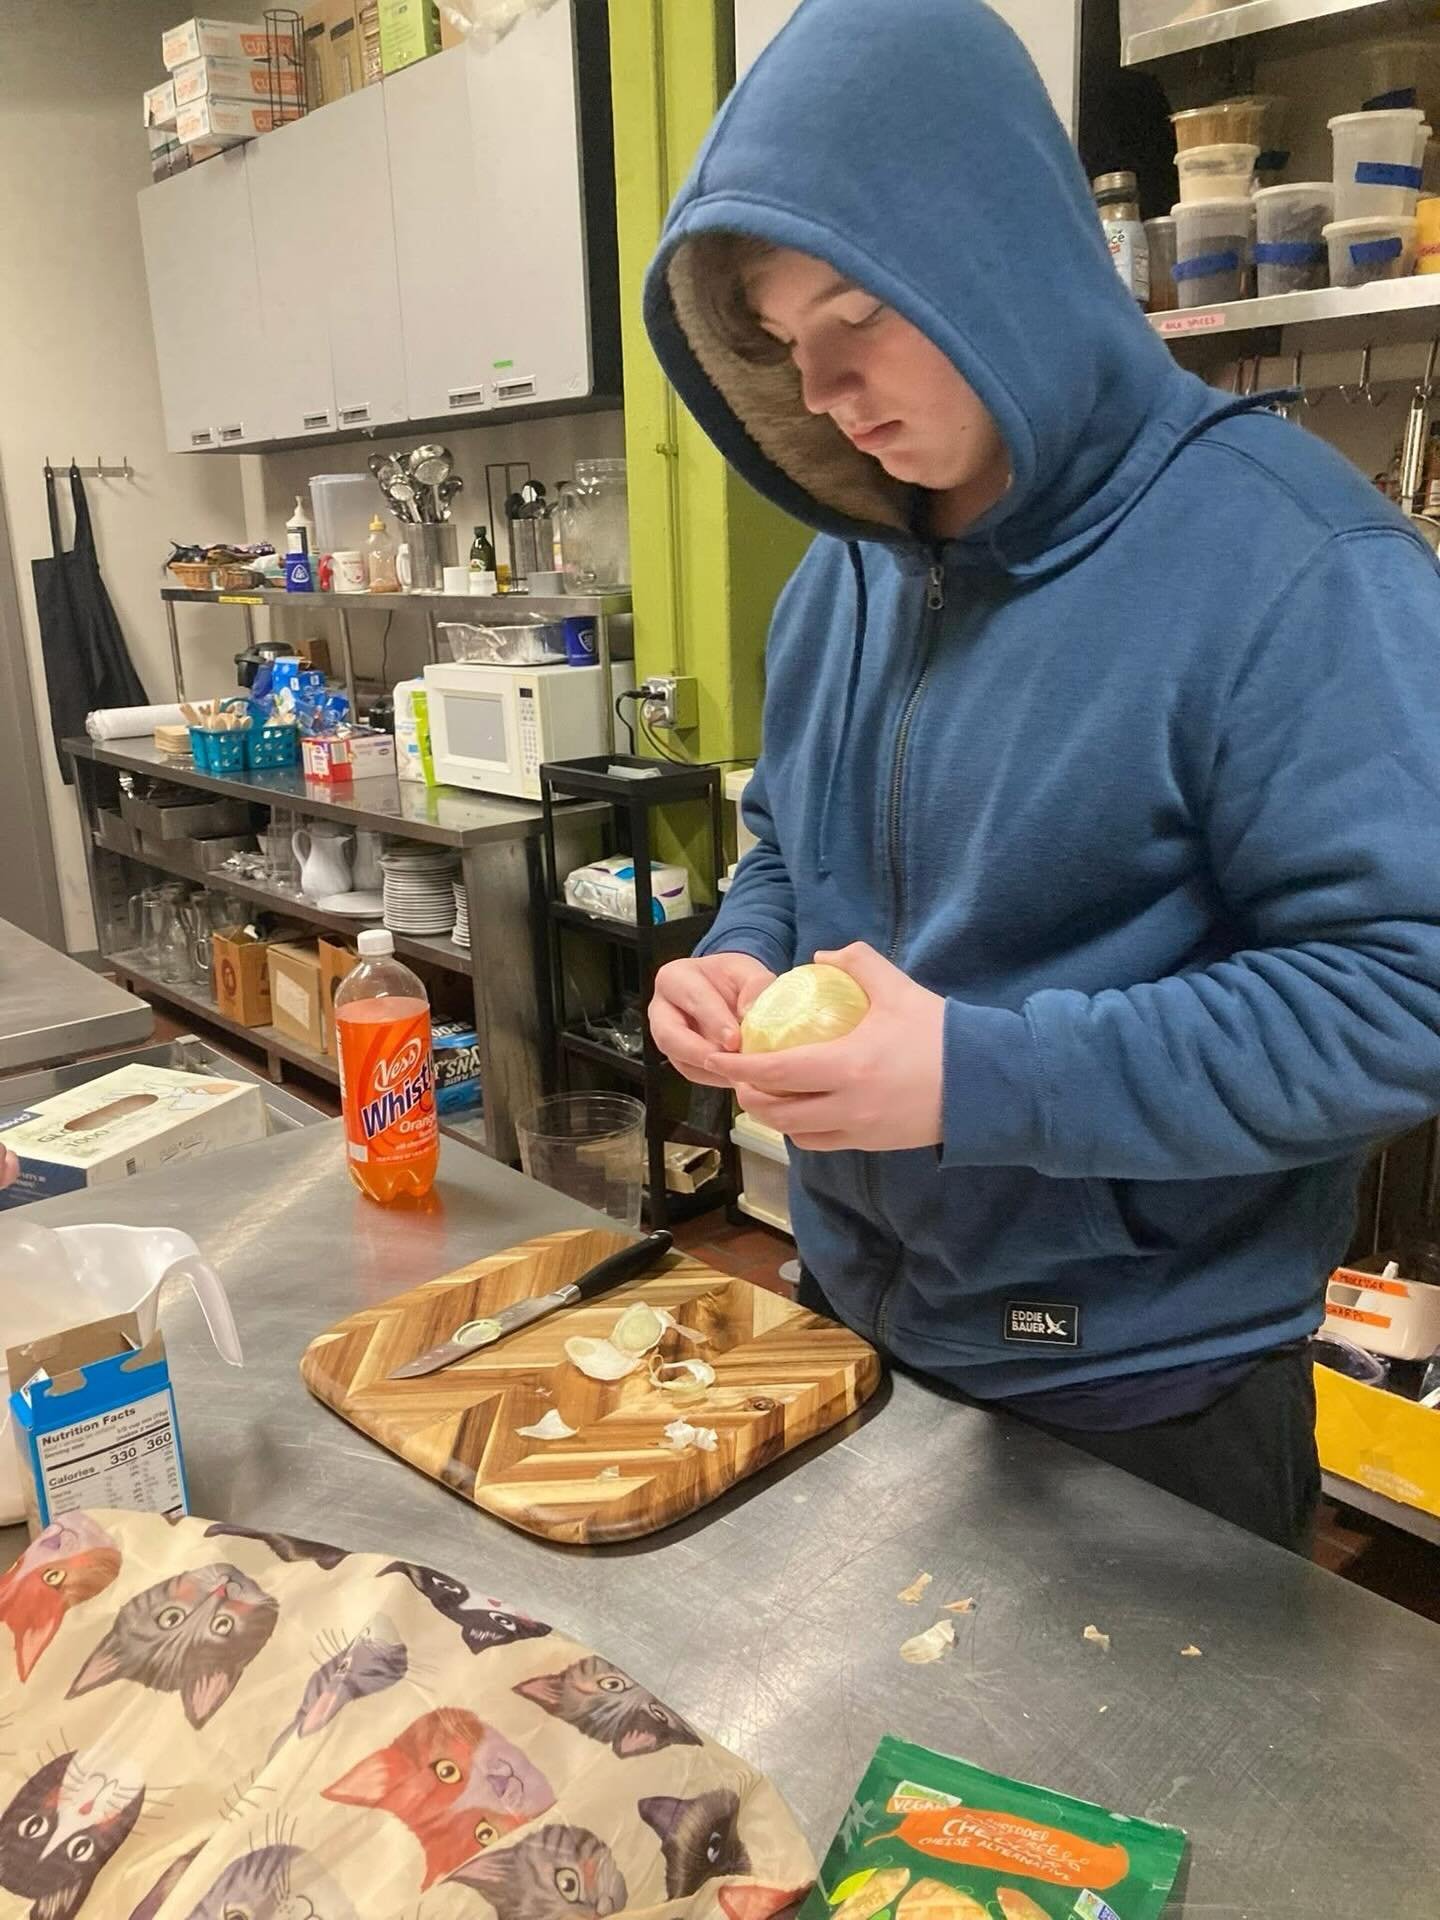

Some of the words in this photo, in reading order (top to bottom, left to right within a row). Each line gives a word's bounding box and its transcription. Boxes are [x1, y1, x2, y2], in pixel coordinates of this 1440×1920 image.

[376, 1048, 417, 1087] Vess
[361, 1060, 432, 1140] Whist
[400, 1116, 433, 1134] Orang
[1011, 1310, 1043, 1322] EDDIE
[1011, 1320, 1045, 1334] BAUER
[42, 1421, 99, 1446] Nutrition
[102, 1407, 136, 1426] Facts
[110, 1447, 137, 1465] 330
[146, 1432, 172, 1450] 360
[48, 1466, 96, 1487] Calories
[893, 1797, 949, 1812] VEGAN
